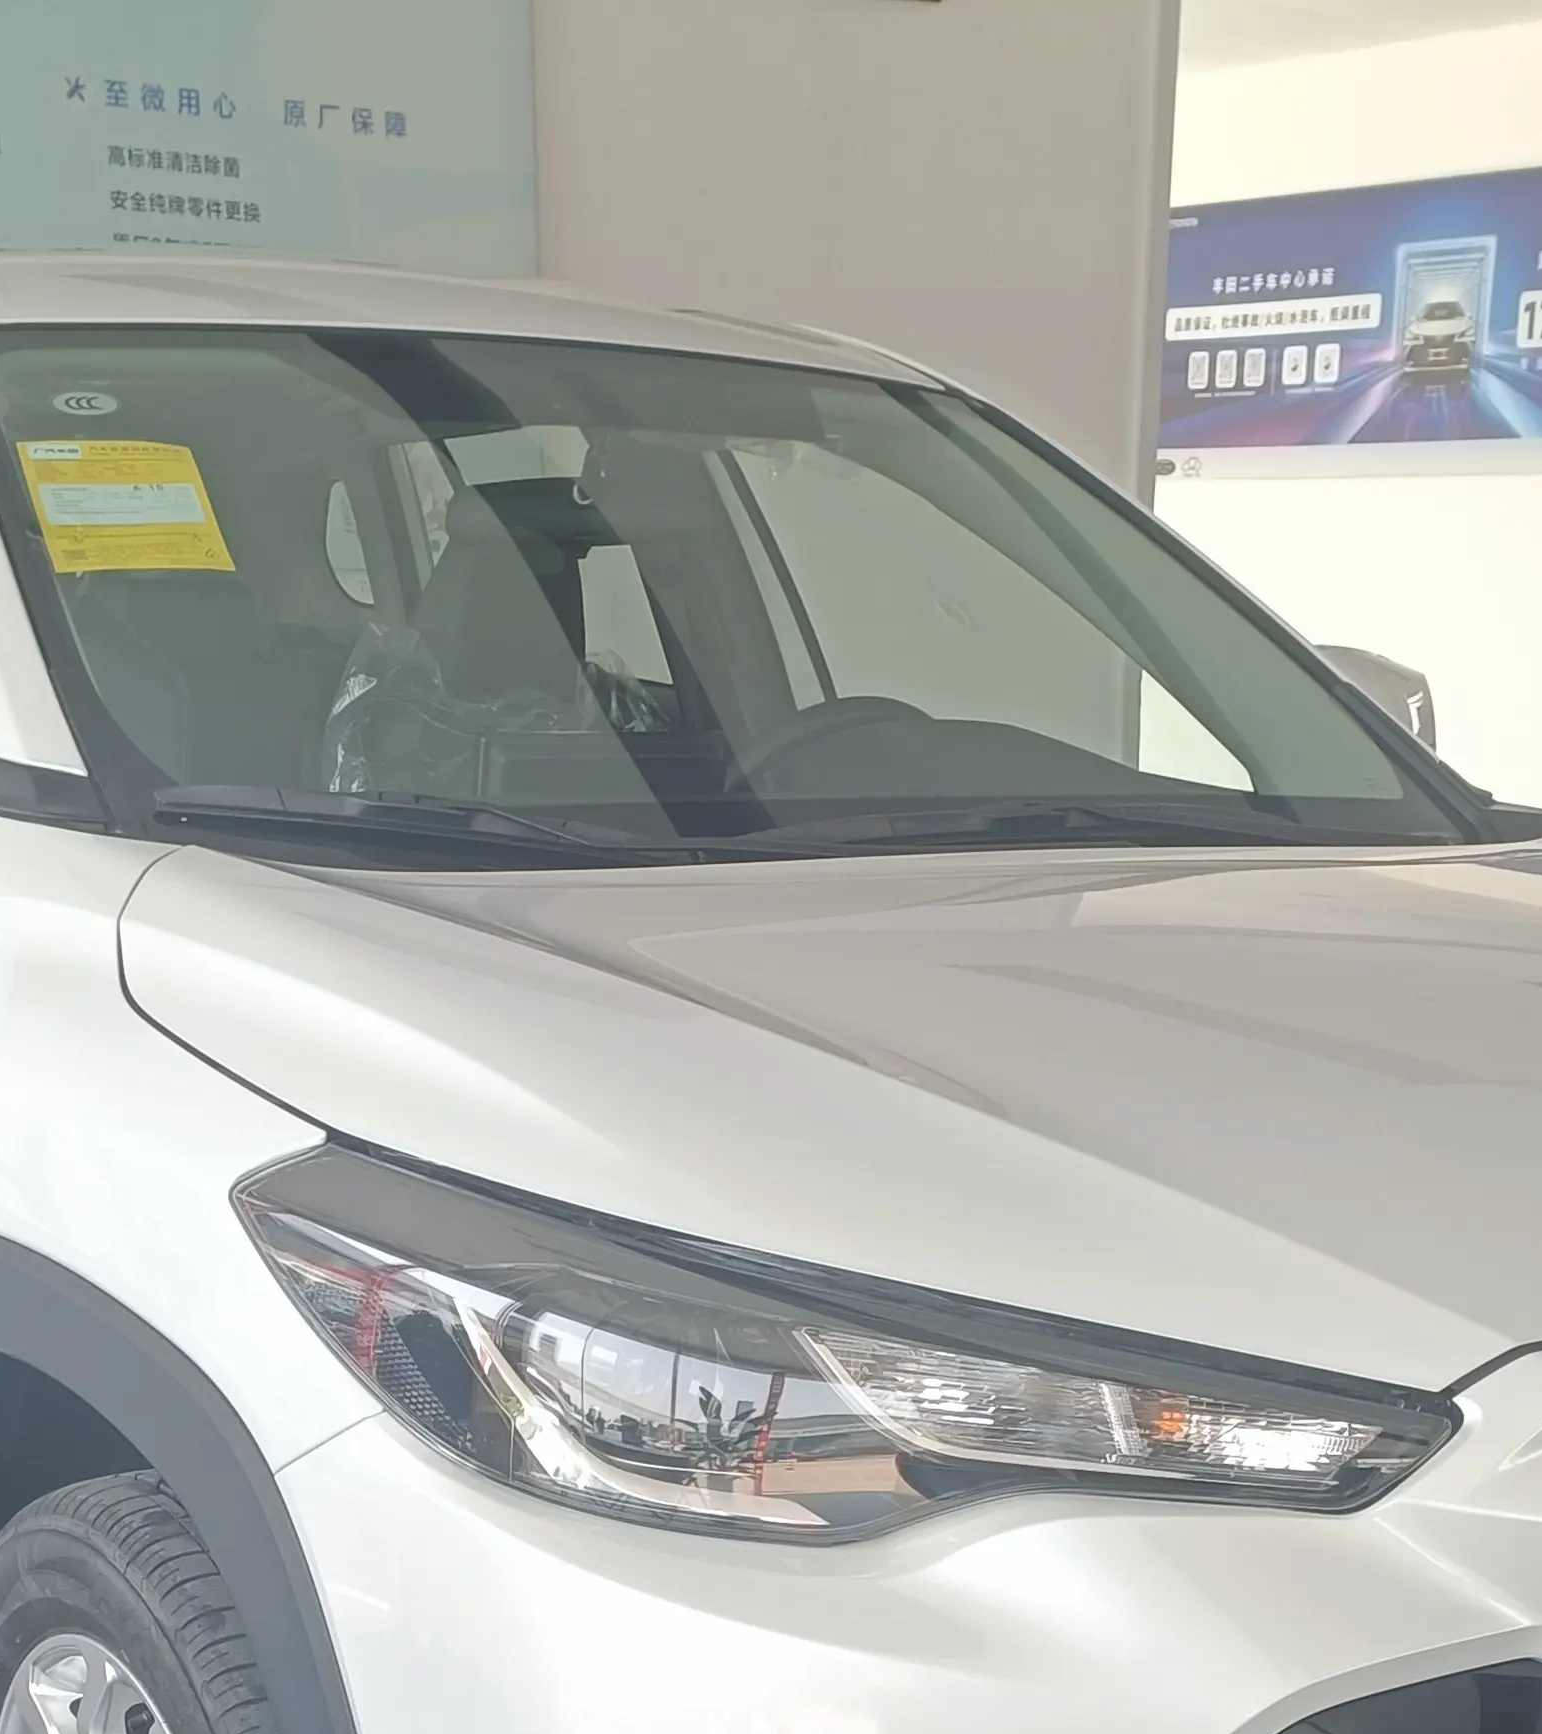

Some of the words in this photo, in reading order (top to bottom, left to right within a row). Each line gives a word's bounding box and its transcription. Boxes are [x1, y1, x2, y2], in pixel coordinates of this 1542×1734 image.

[104, 79, 237, 119] 至微用心
[284, 99, 408, 138] 原厂保障
[107, 145, 240, 179] 高标准清洁除菌
[110, 190, 262, 223] 安全纯牌零件更换
